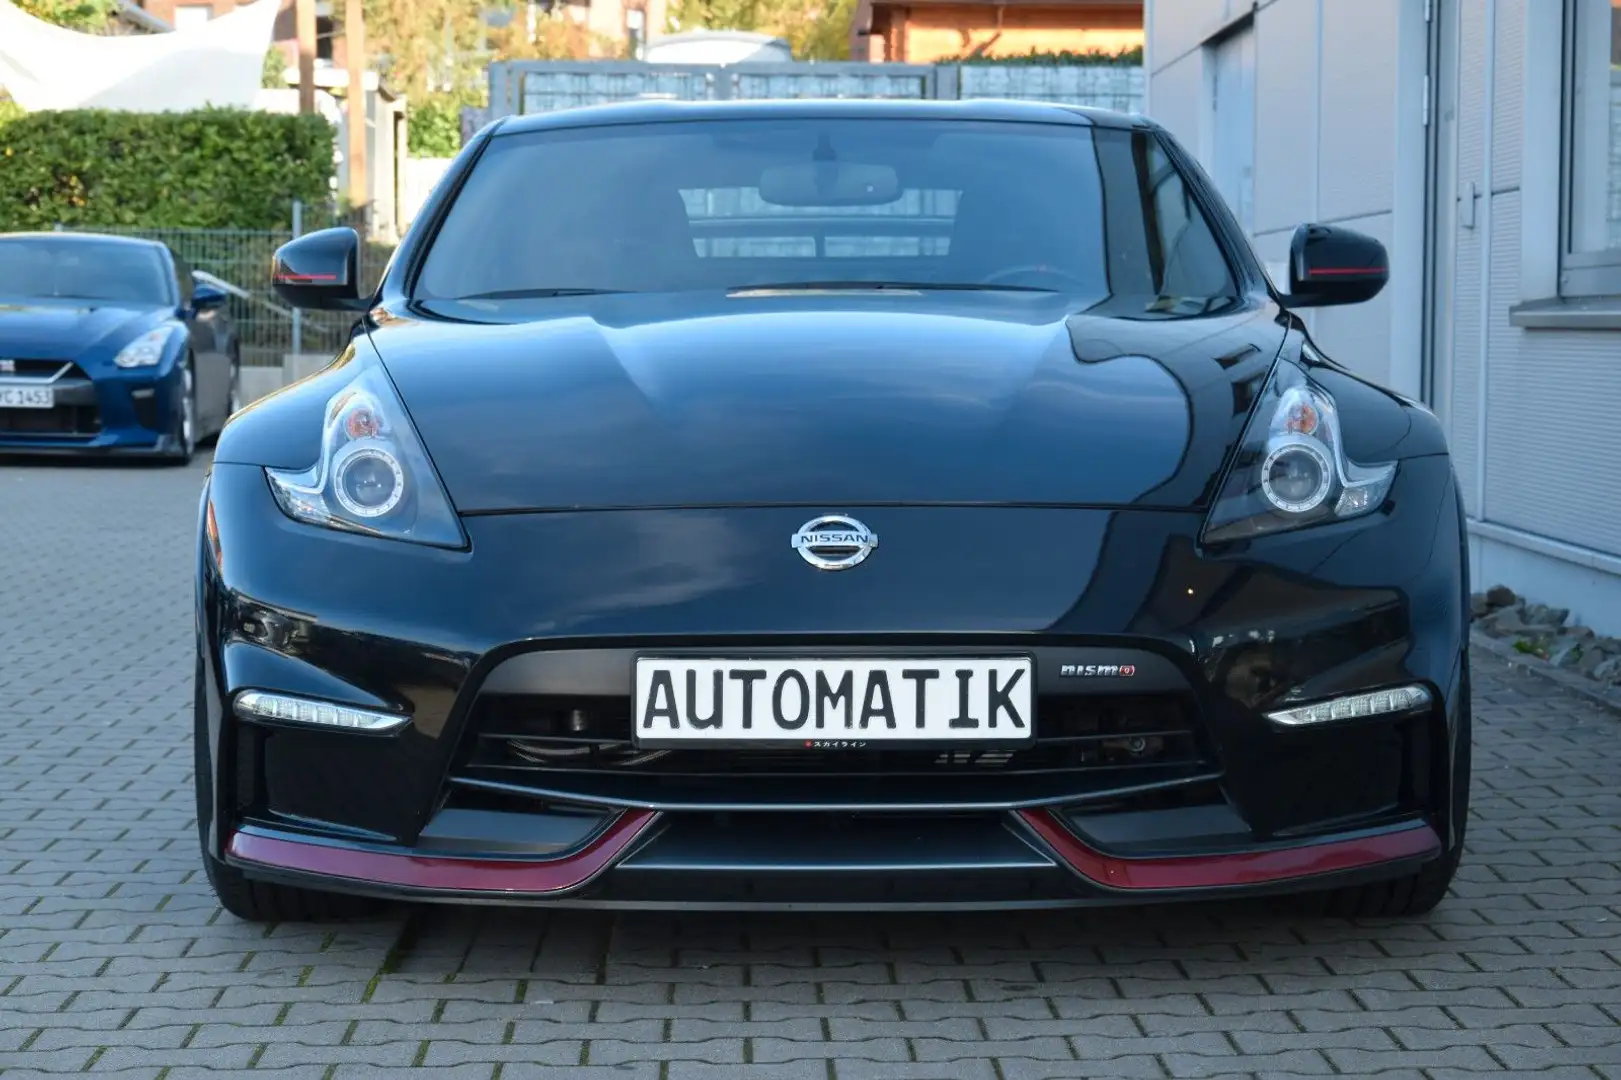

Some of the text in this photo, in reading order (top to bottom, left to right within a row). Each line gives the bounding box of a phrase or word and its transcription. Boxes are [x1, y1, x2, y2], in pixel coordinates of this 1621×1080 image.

[18, 390, 50, 404] 1453
[800, 533, 868, 544] NISSAN
[642, 669, 1026, 730] AUTOMATIK
